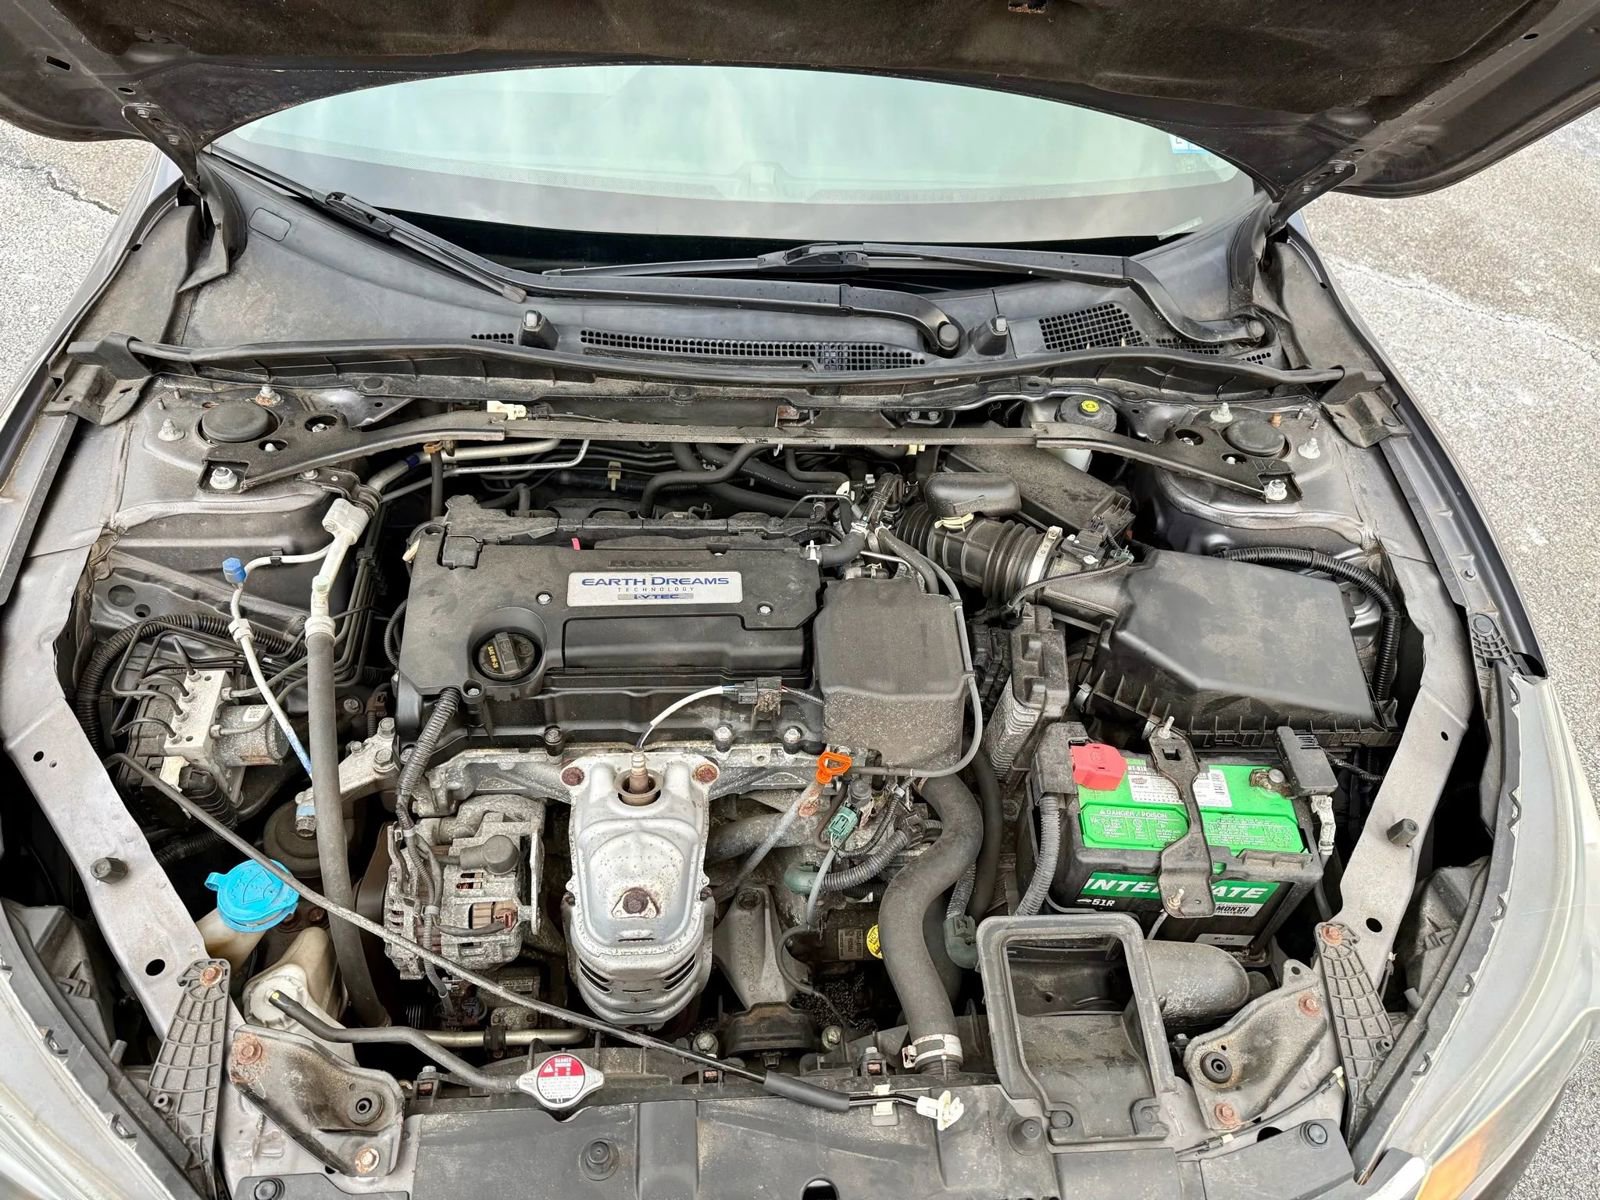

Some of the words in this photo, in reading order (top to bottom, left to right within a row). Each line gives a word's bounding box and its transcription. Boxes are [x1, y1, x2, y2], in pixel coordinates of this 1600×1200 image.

[581, 578, 646, 586] EARTH
[651, 576, 729, 585] DREAMS
[1091, 899, 1116, 907] 51R
[1215, 905, 1250, 913] MONTH
